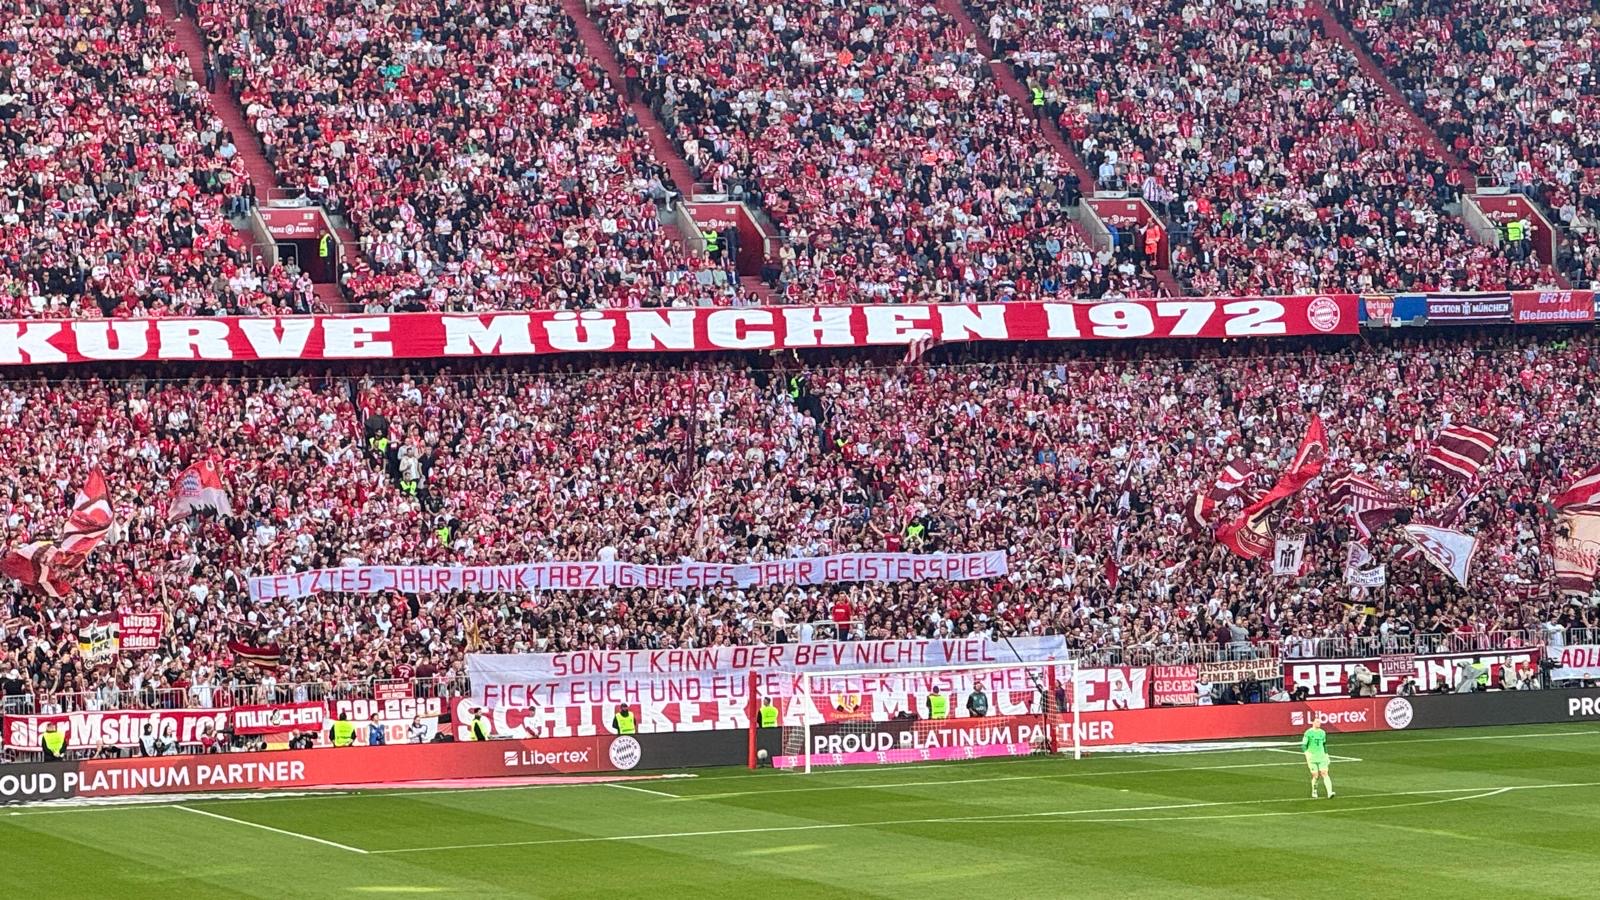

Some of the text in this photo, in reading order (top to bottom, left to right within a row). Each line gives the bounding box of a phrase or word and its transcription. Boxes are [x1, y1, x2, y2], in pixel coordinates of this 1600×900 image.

[1539, 292, 1572, 304] BFC 75
[1430, 302, 1509, 314] SEKTION MÜNCHEN
[1519, 308, 1589, 321] Kleinostheim
[0, 299, 1287, 362] KURVE MÜNCHEN 1972
[257, 568, 371, 601] LETZTES
[384, 568, 450, 591] JAHR
[645, 566, 734, 589] DIESES
[750, 561, 812, 588] JAHR
[825, 555, 998, 581] GEISTERSPIEL
[123, 615, 157, 628] ultras
[553, 640, 996, 676] SONST KANN DER BFV NICHT VIEL
[1382, 660, 1413, 671] JUNGS
[1154, 666, 1198, 679] ULTRAS
[1200, 659, 1279, 673] AUSGESPERRTE
[1238, 670, 1252, 682] BE
[1257, 668, 1278, 679] UNS
[484, 683, 559, 707] FICKT
[570, 680, 640, 704] EUCH
[650, 676, 701, 701] UND
[713, 673, 781, 699] EURE
[456, 696, 827, 742] SCHICKERA
[1307, 710, 1367, 725] Libertex
[815, 720, 1115, 755] PROUD PLATINUM PATNER
[522, 749, 588, 765] Libertex
[0, 760, 305, 796] OUD PLATINUM PARTNER
